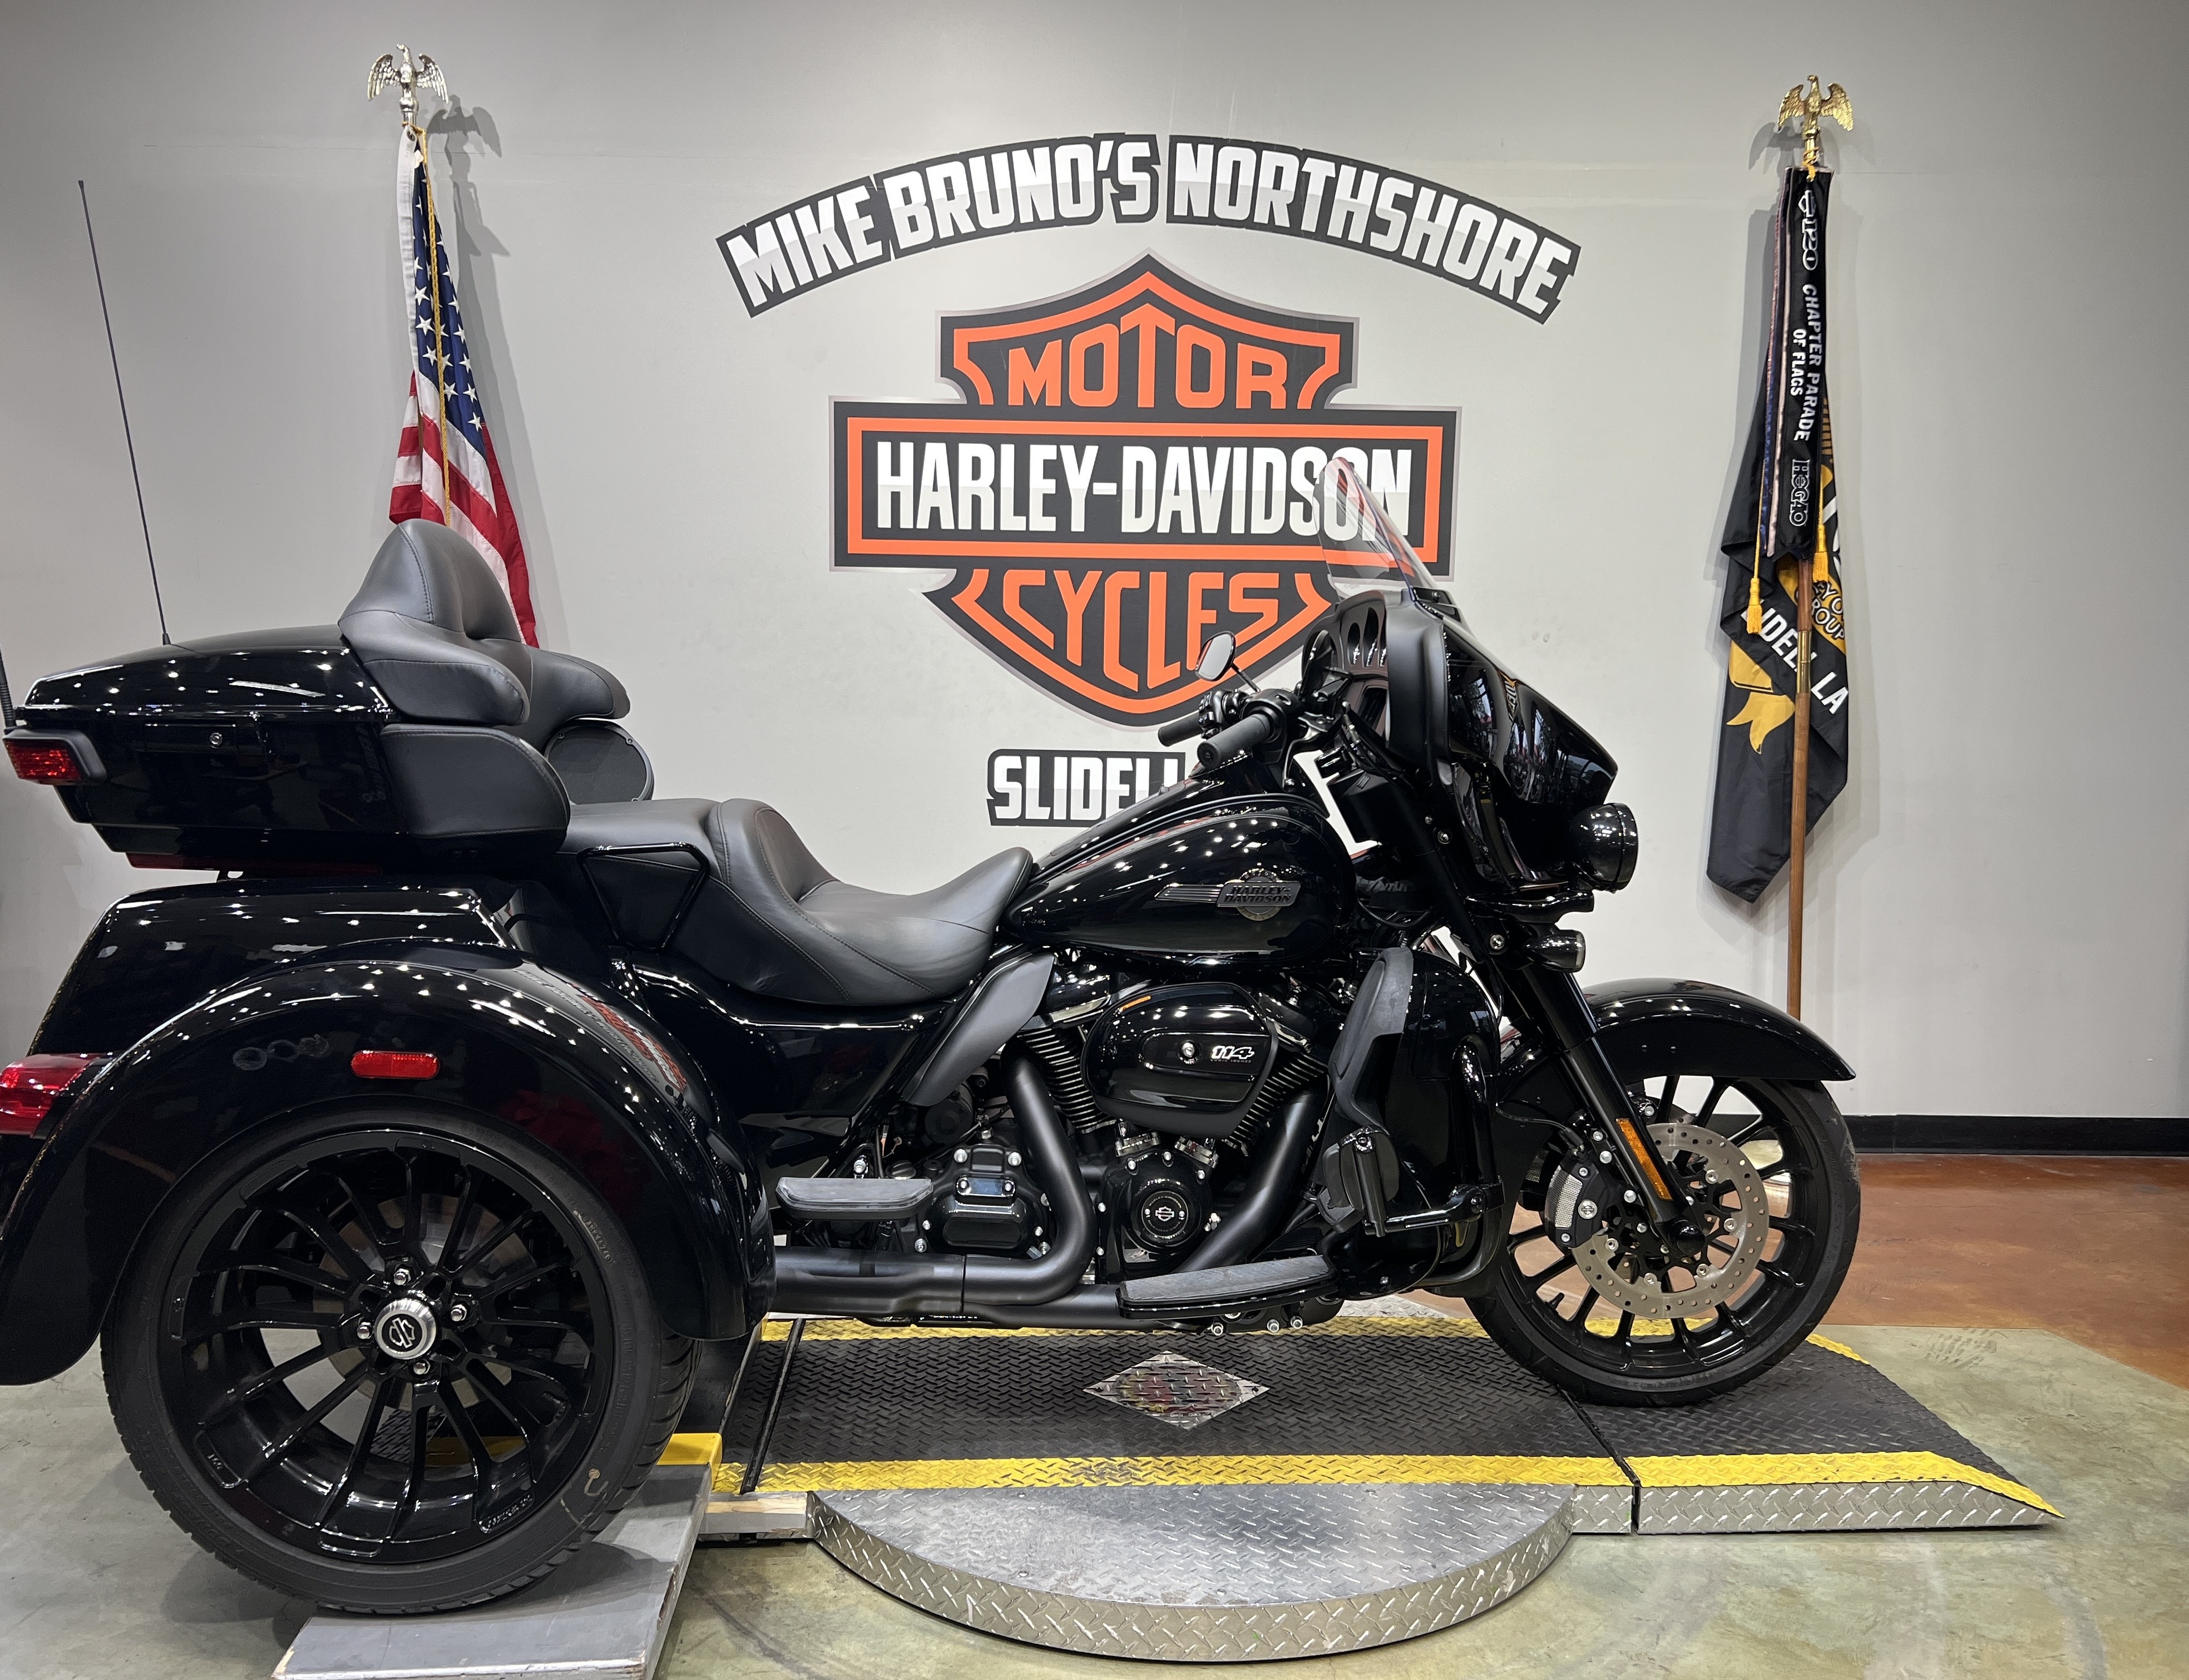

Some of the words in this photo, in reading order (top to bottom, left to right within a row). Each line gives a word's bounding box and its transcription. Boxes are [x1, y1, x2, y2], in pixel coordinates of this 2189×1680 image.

[725, 186, 883, 308] MIKE
[882, 140, 1153, 250] BRUNO'S
[1173, 142, 1573, 315] NORTHSHORE
[1008, 304, 1287, 409] MOTOR
[1793, 328, 1807, 348] OF
[1802, 284, 1823, 367] CHAPTER
[1790, 352, 1806, 396] FLAGS
[1793, 372, 1821, 442] PARADE
[877, 441, 1412, 542] HARLEY-DAVIDSON
[1002, 569, 1279, 691] CYCLES
[1796, 597, 1845, 639] ROUP
[1810, 671, 1849, 714] LA
[1211, 1045, 1255, 1060] 114
